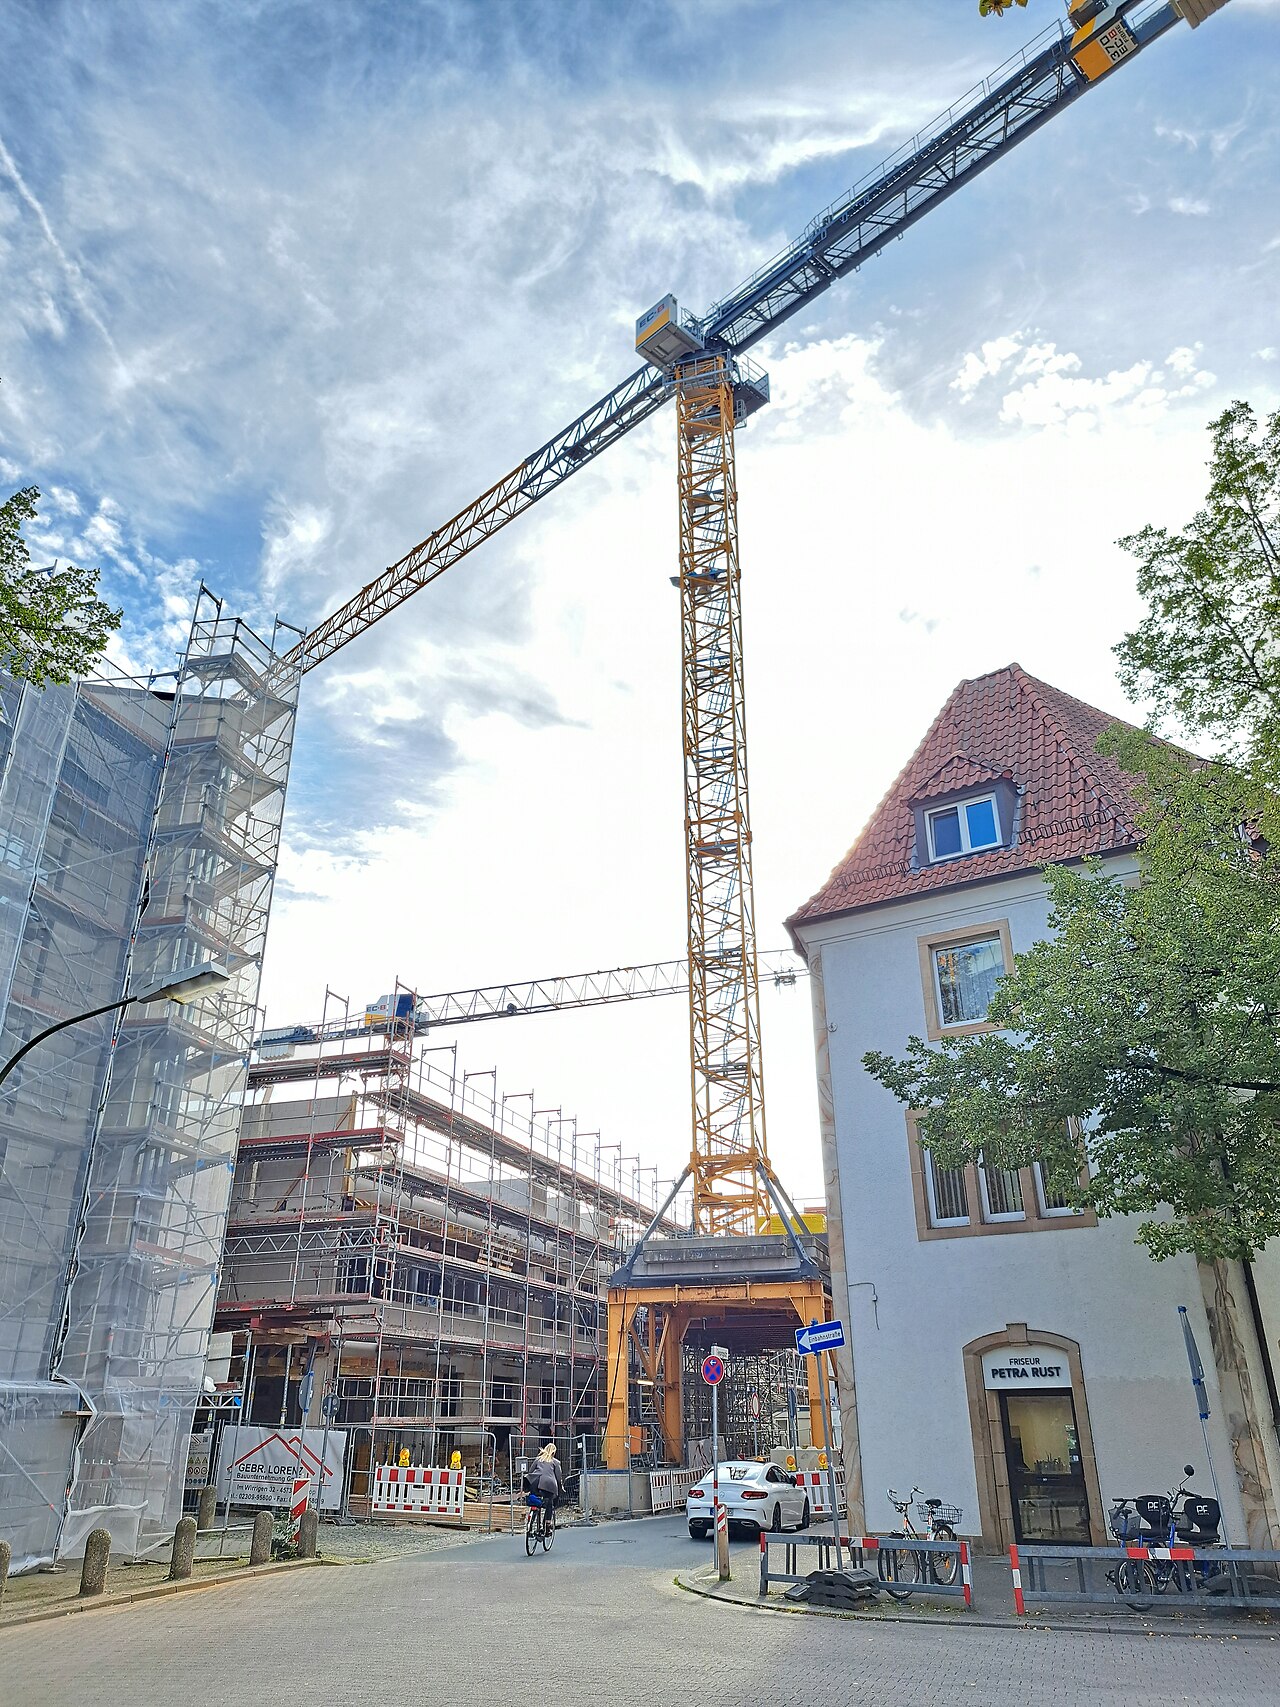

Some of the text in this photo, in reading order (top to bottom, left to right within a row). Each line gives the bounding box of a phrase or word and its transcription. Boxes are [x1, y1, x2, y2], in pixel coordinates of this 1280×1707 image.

[1100, 35, 1120, 60] 370
[809, 1331, 841, 1343] Einbahnstraße
[991, 1367, 1061, 1378] PETRA RUST
[238, 1463, 304, 1476] GEBR. LORENZ
[236, 1472, 286, 1482] Bauunternehmung
